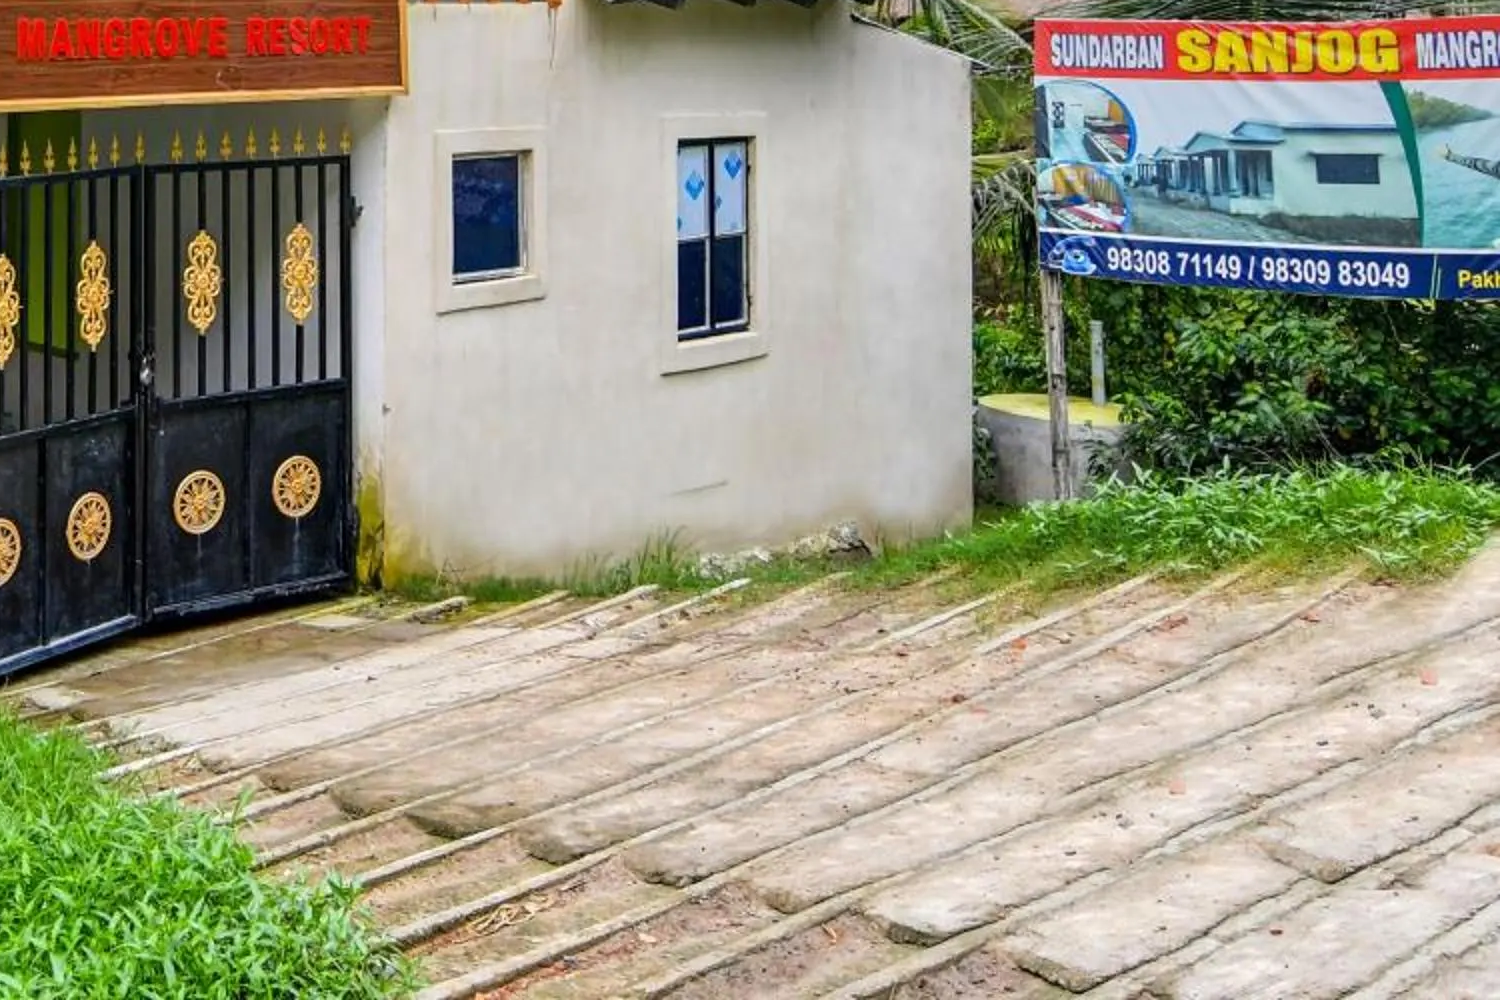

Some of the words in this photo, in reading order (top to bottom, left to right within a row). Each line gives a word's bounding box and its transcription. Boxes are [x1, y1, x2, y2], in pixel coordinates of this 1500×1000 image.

[17, 17, 228, 61] MANGROVE
[246, 17, 372, 57] RESORT
[1051, 33, 1163, 69] SUNDARBAN
[1176, 28, 1400, 74] SANJOG
[1415, 30, 1500, 69] MANGR
[1107, 247, 1171, 275] 98308
[1177, 252, 1241, 281] 71149
[1261, 257, 1330, 286] 98309
[1338, 261, 1410, 289] 83049
